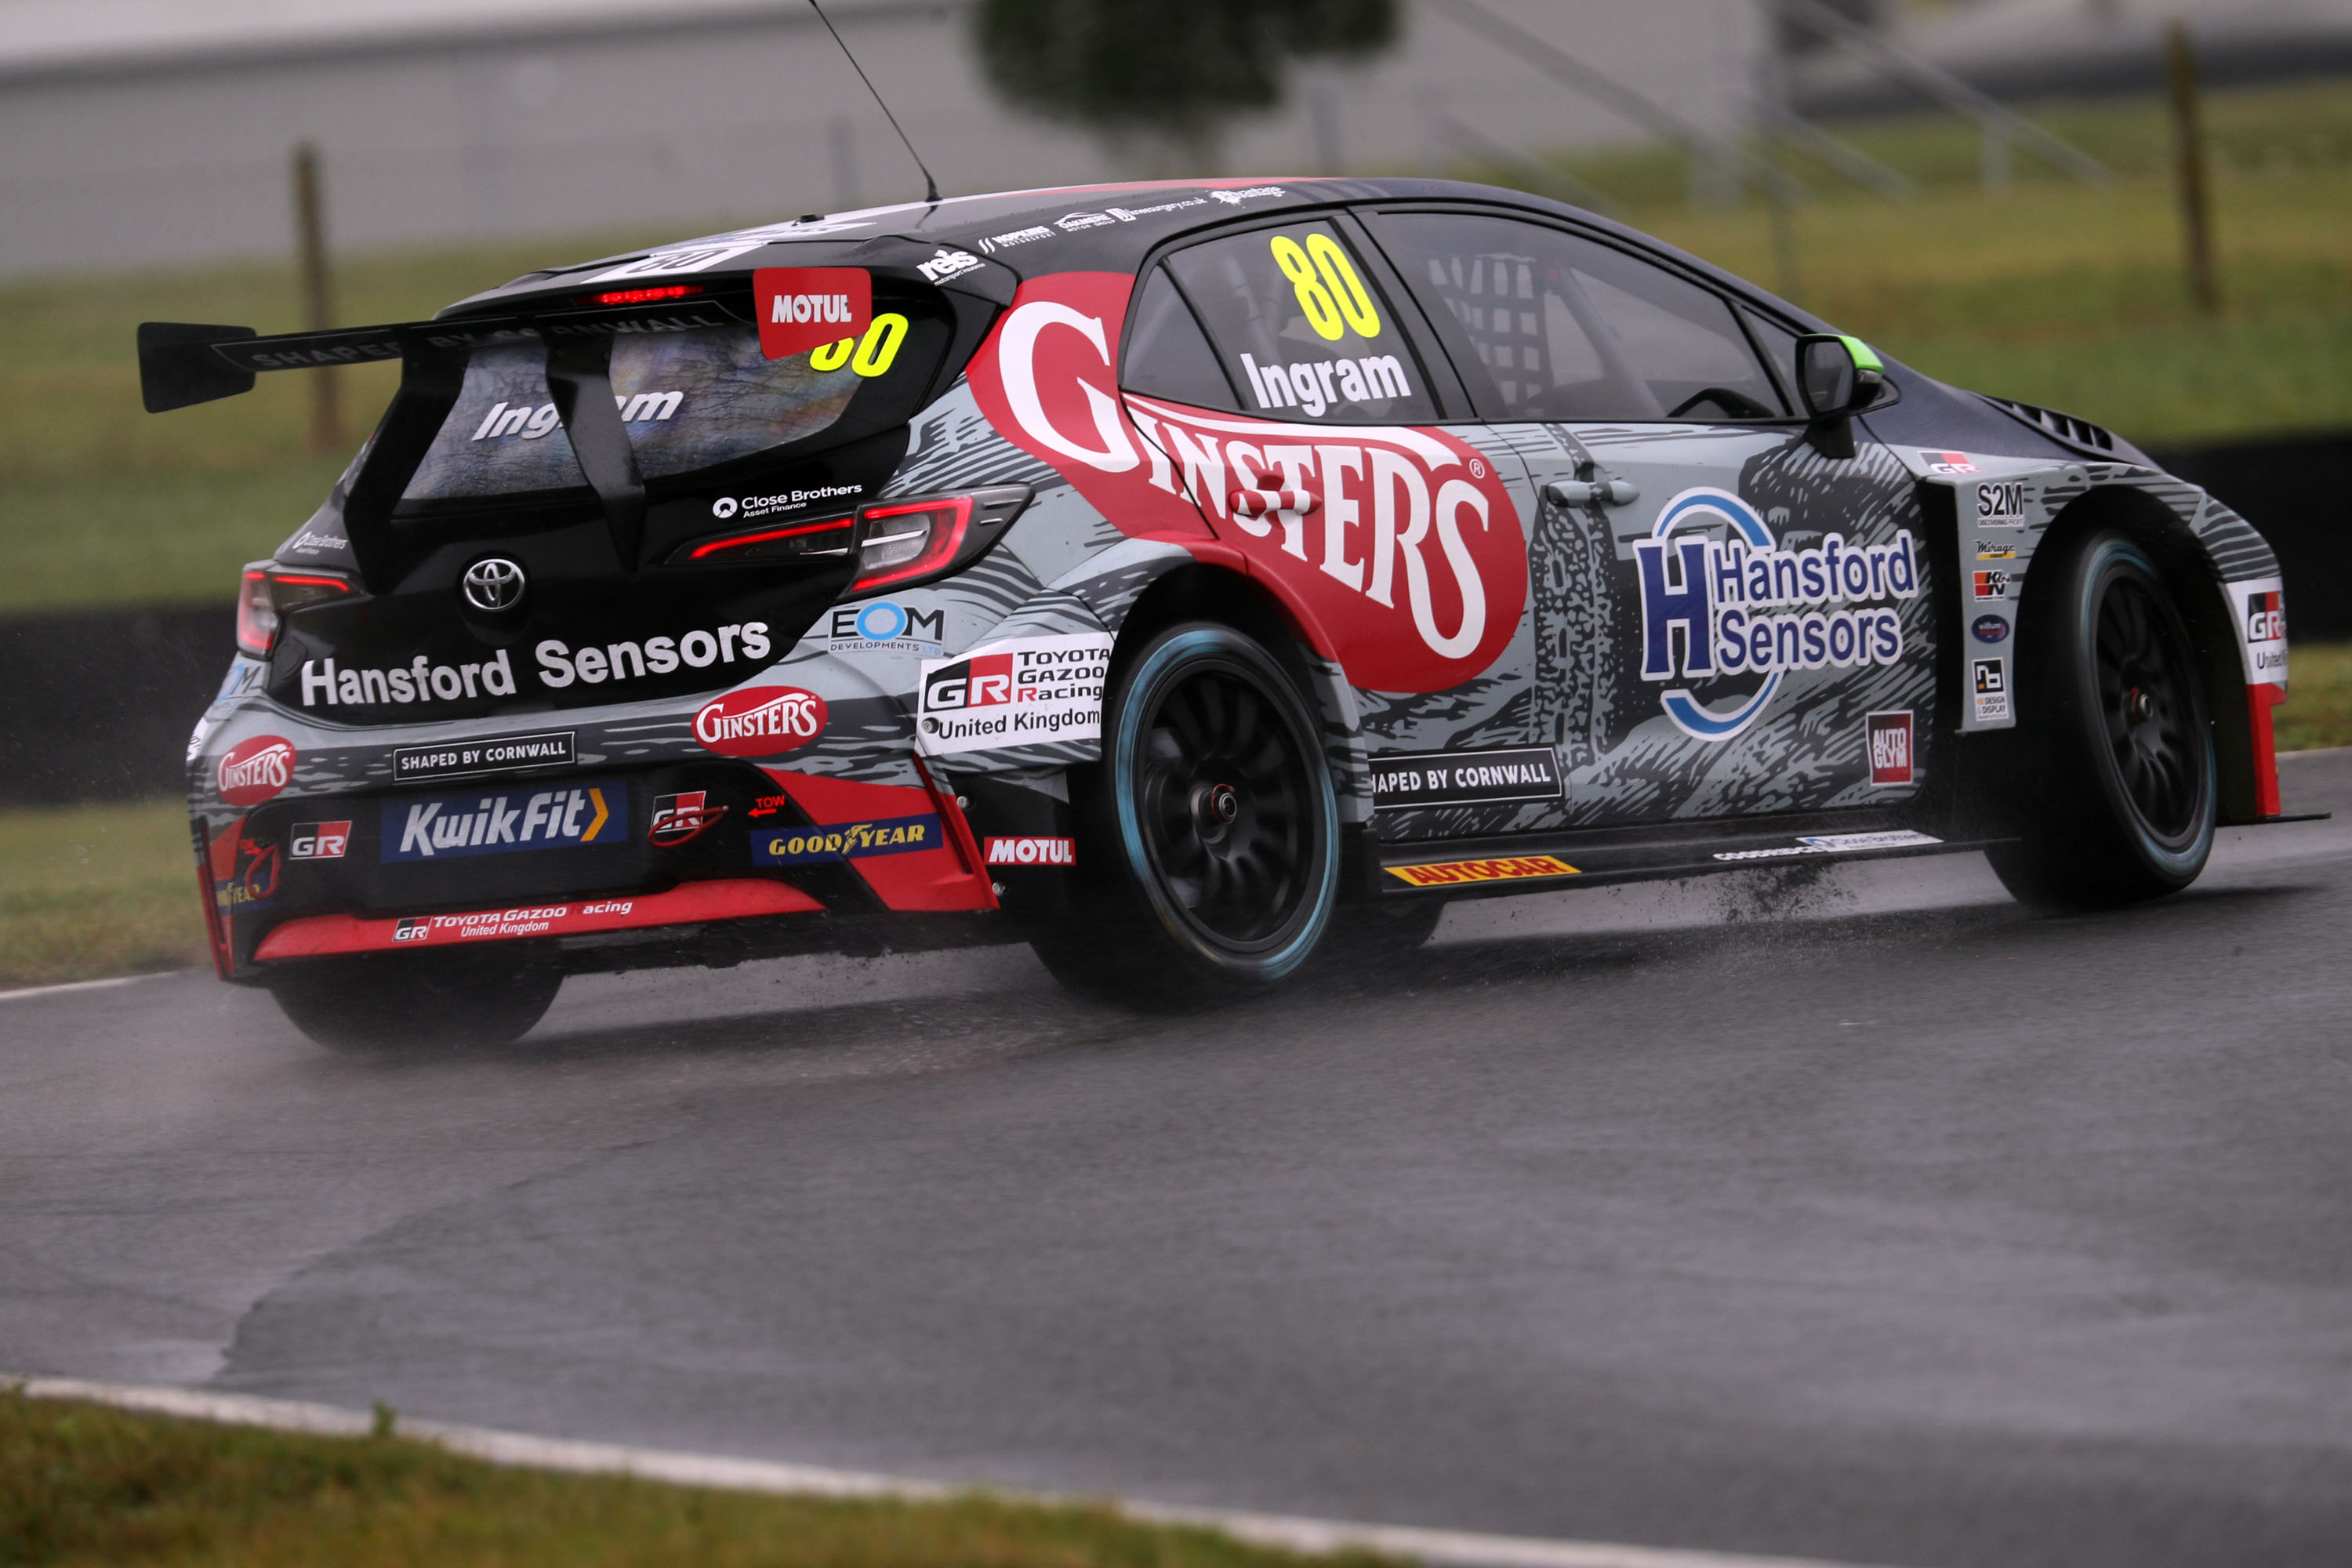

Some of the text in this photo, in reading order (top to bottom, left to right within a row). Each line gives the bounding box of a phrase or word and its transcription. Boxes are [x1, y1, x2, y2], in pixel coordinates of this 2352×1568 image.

[916, 249, 978, 281] reis
[1270, 233, 1381, 341] 80
[771, 294, 852, 324] MOTUL
[1240, 352, 1412, 418] Ingram
[471, 390, 684, 440] Ingm
[999, 300, 1490, 659] GINSTERS
[741, 485, 862, 510] Close Brothers
[742, 501, 807, 519] Asset Finance
[1978, 484, 2023, 516] S2M
[1976, 540, 2015, 554] Mirage
[1714, 537, 1915, 603] Hansford
[831, 601, 945, 641] EOM
[2249, 610, 2282, 640] GR
[830, 641, 941, 655] DEVELOPMENTS LTD
[1719, 608, 1899, 668] Sensors
[301, 622, 771, 706] Hansford Sensors
[1018, 648, 1111, 666] TOYOTA
[1018, 666, 1105, 684] GAZOO
[927, 674, 1010, 710] GR
[1018, 684, 1103, 702] Racing
[695, 692, 818, 744] GINSTERS
[938, 708, 1101, 739] United Kingdom
[1874, 728, 1907, 748] AUTO
[218, 743, 291, 792] GINSTERS
[401, 741, 567, 771] SHAPED BY CORNWALL
[1874, 748, 1907, 768] GLYM
[1371, 763, 1552, 793] HAPED BY CORNWALL
[755, 795, 785, 809] TOW
[399, 788, 587, 856] KwikFit
[292, 834, 346, 856] GR
[989, 840, 1073, 863] MOTUL
[1403, 858, 1569, 884] AUTOCAR
[434, 914, 500, 928] TOYOTA
[503, 906, 568, 921] GAZOO
[461, 920, 550, 937] United Kingdom
[394, 925, 427, 940] GR
